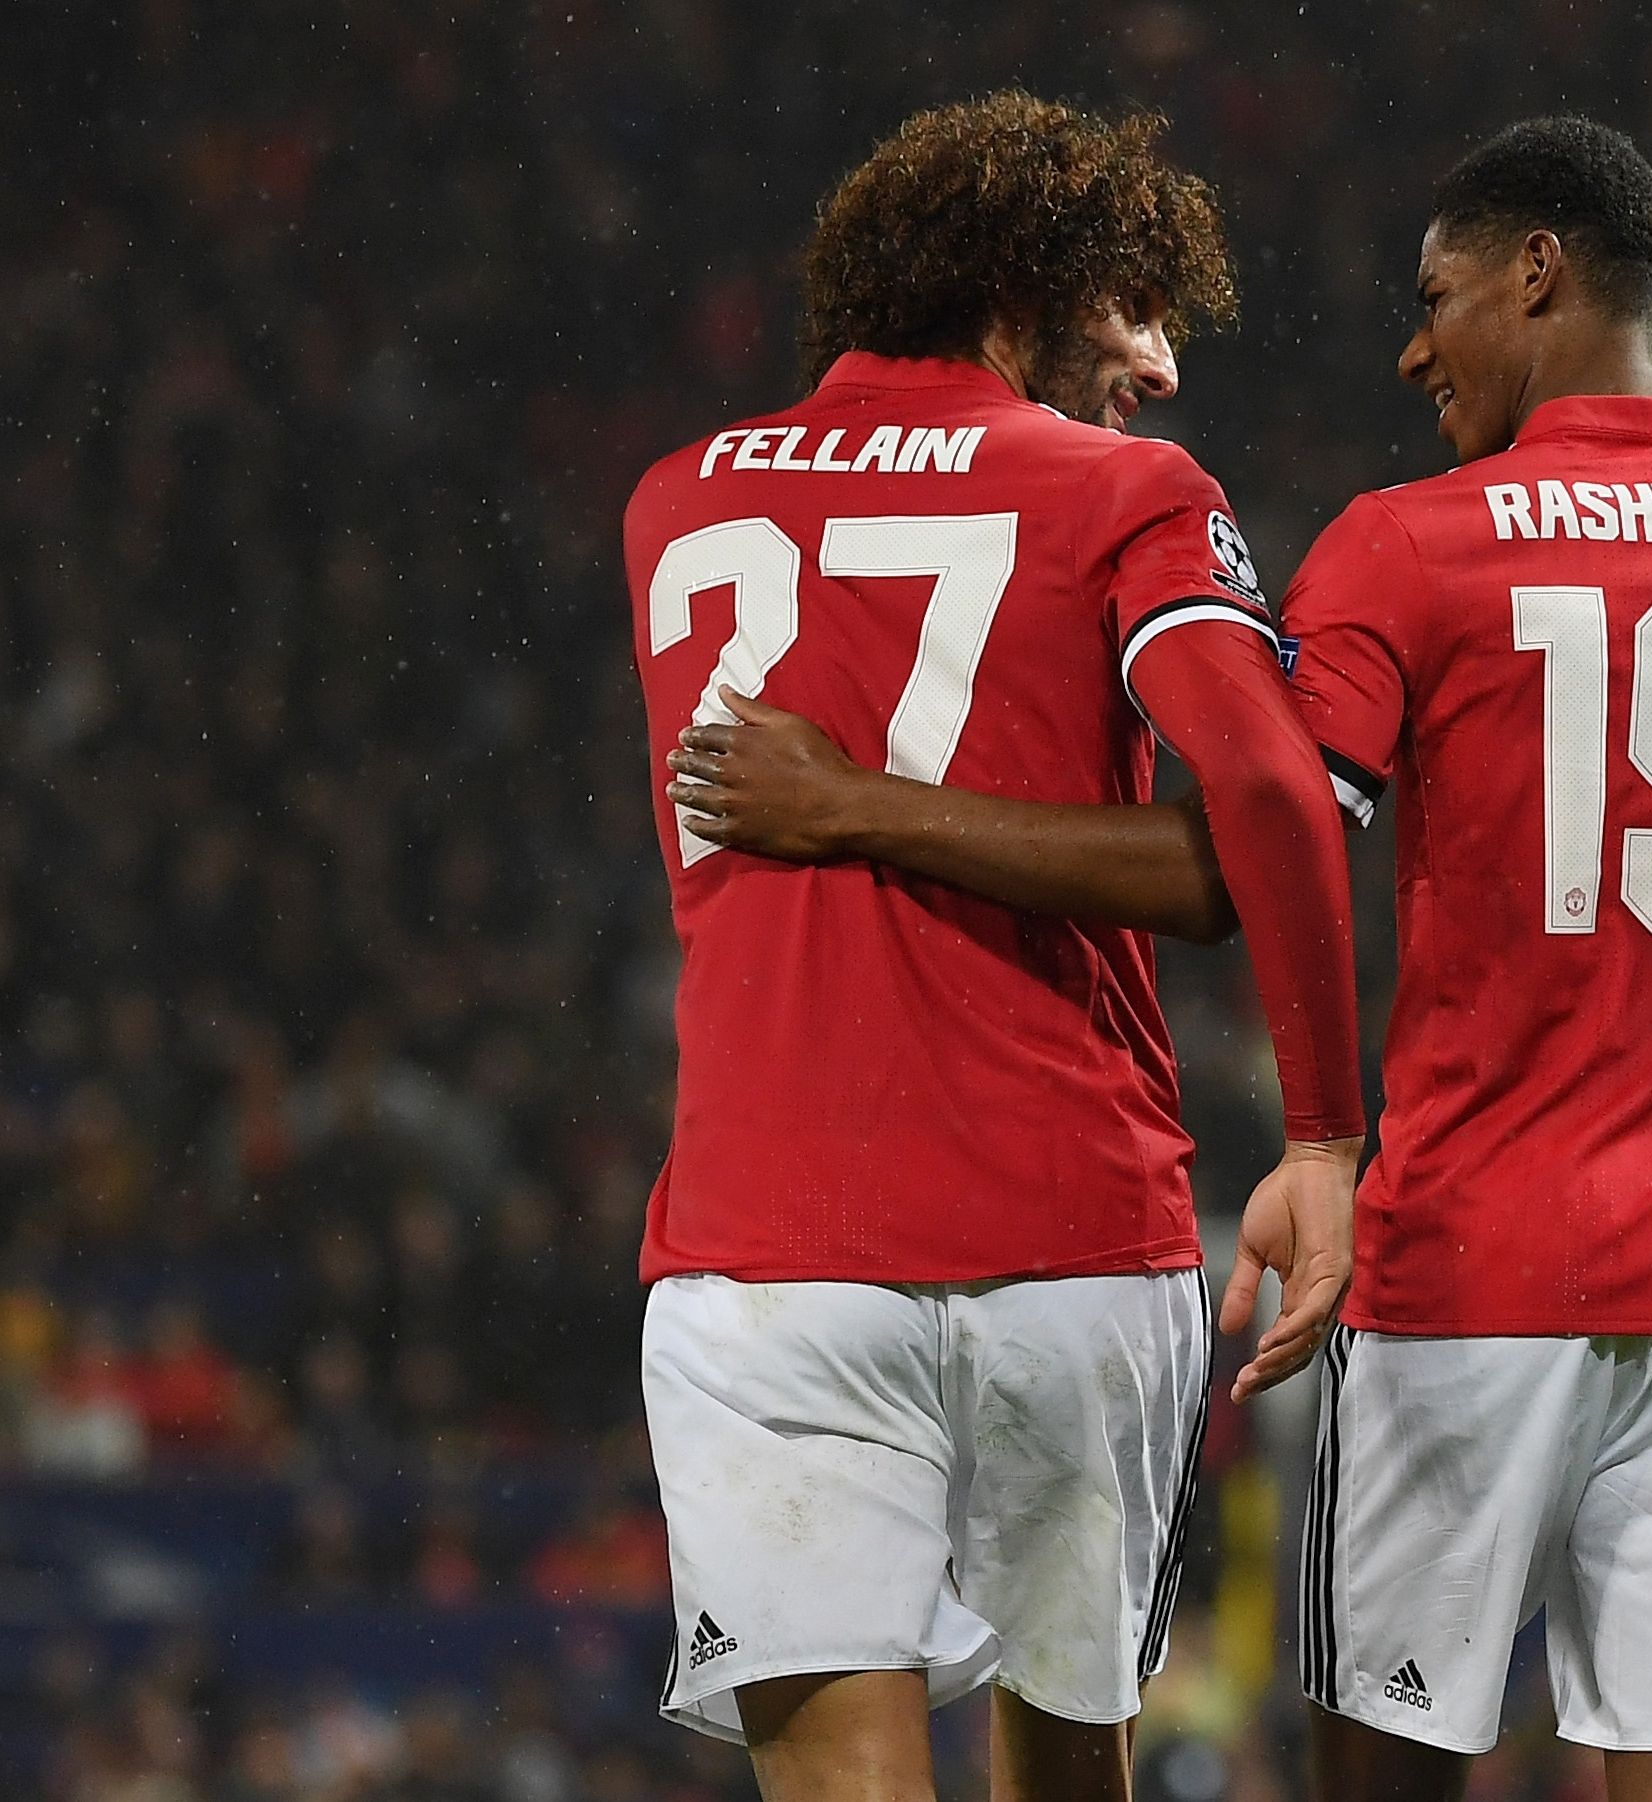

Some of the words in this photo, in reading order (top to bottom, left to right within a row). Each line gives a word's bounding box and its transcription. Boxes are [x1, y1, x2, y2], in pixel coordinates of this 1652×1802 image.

[698, 425, 988, 480] FELLAINI
[648, 511, 1019, 870] 27
[689, 1637, 739, 1671] adidas
[1384, 1684, 1432, 1712] adidas
